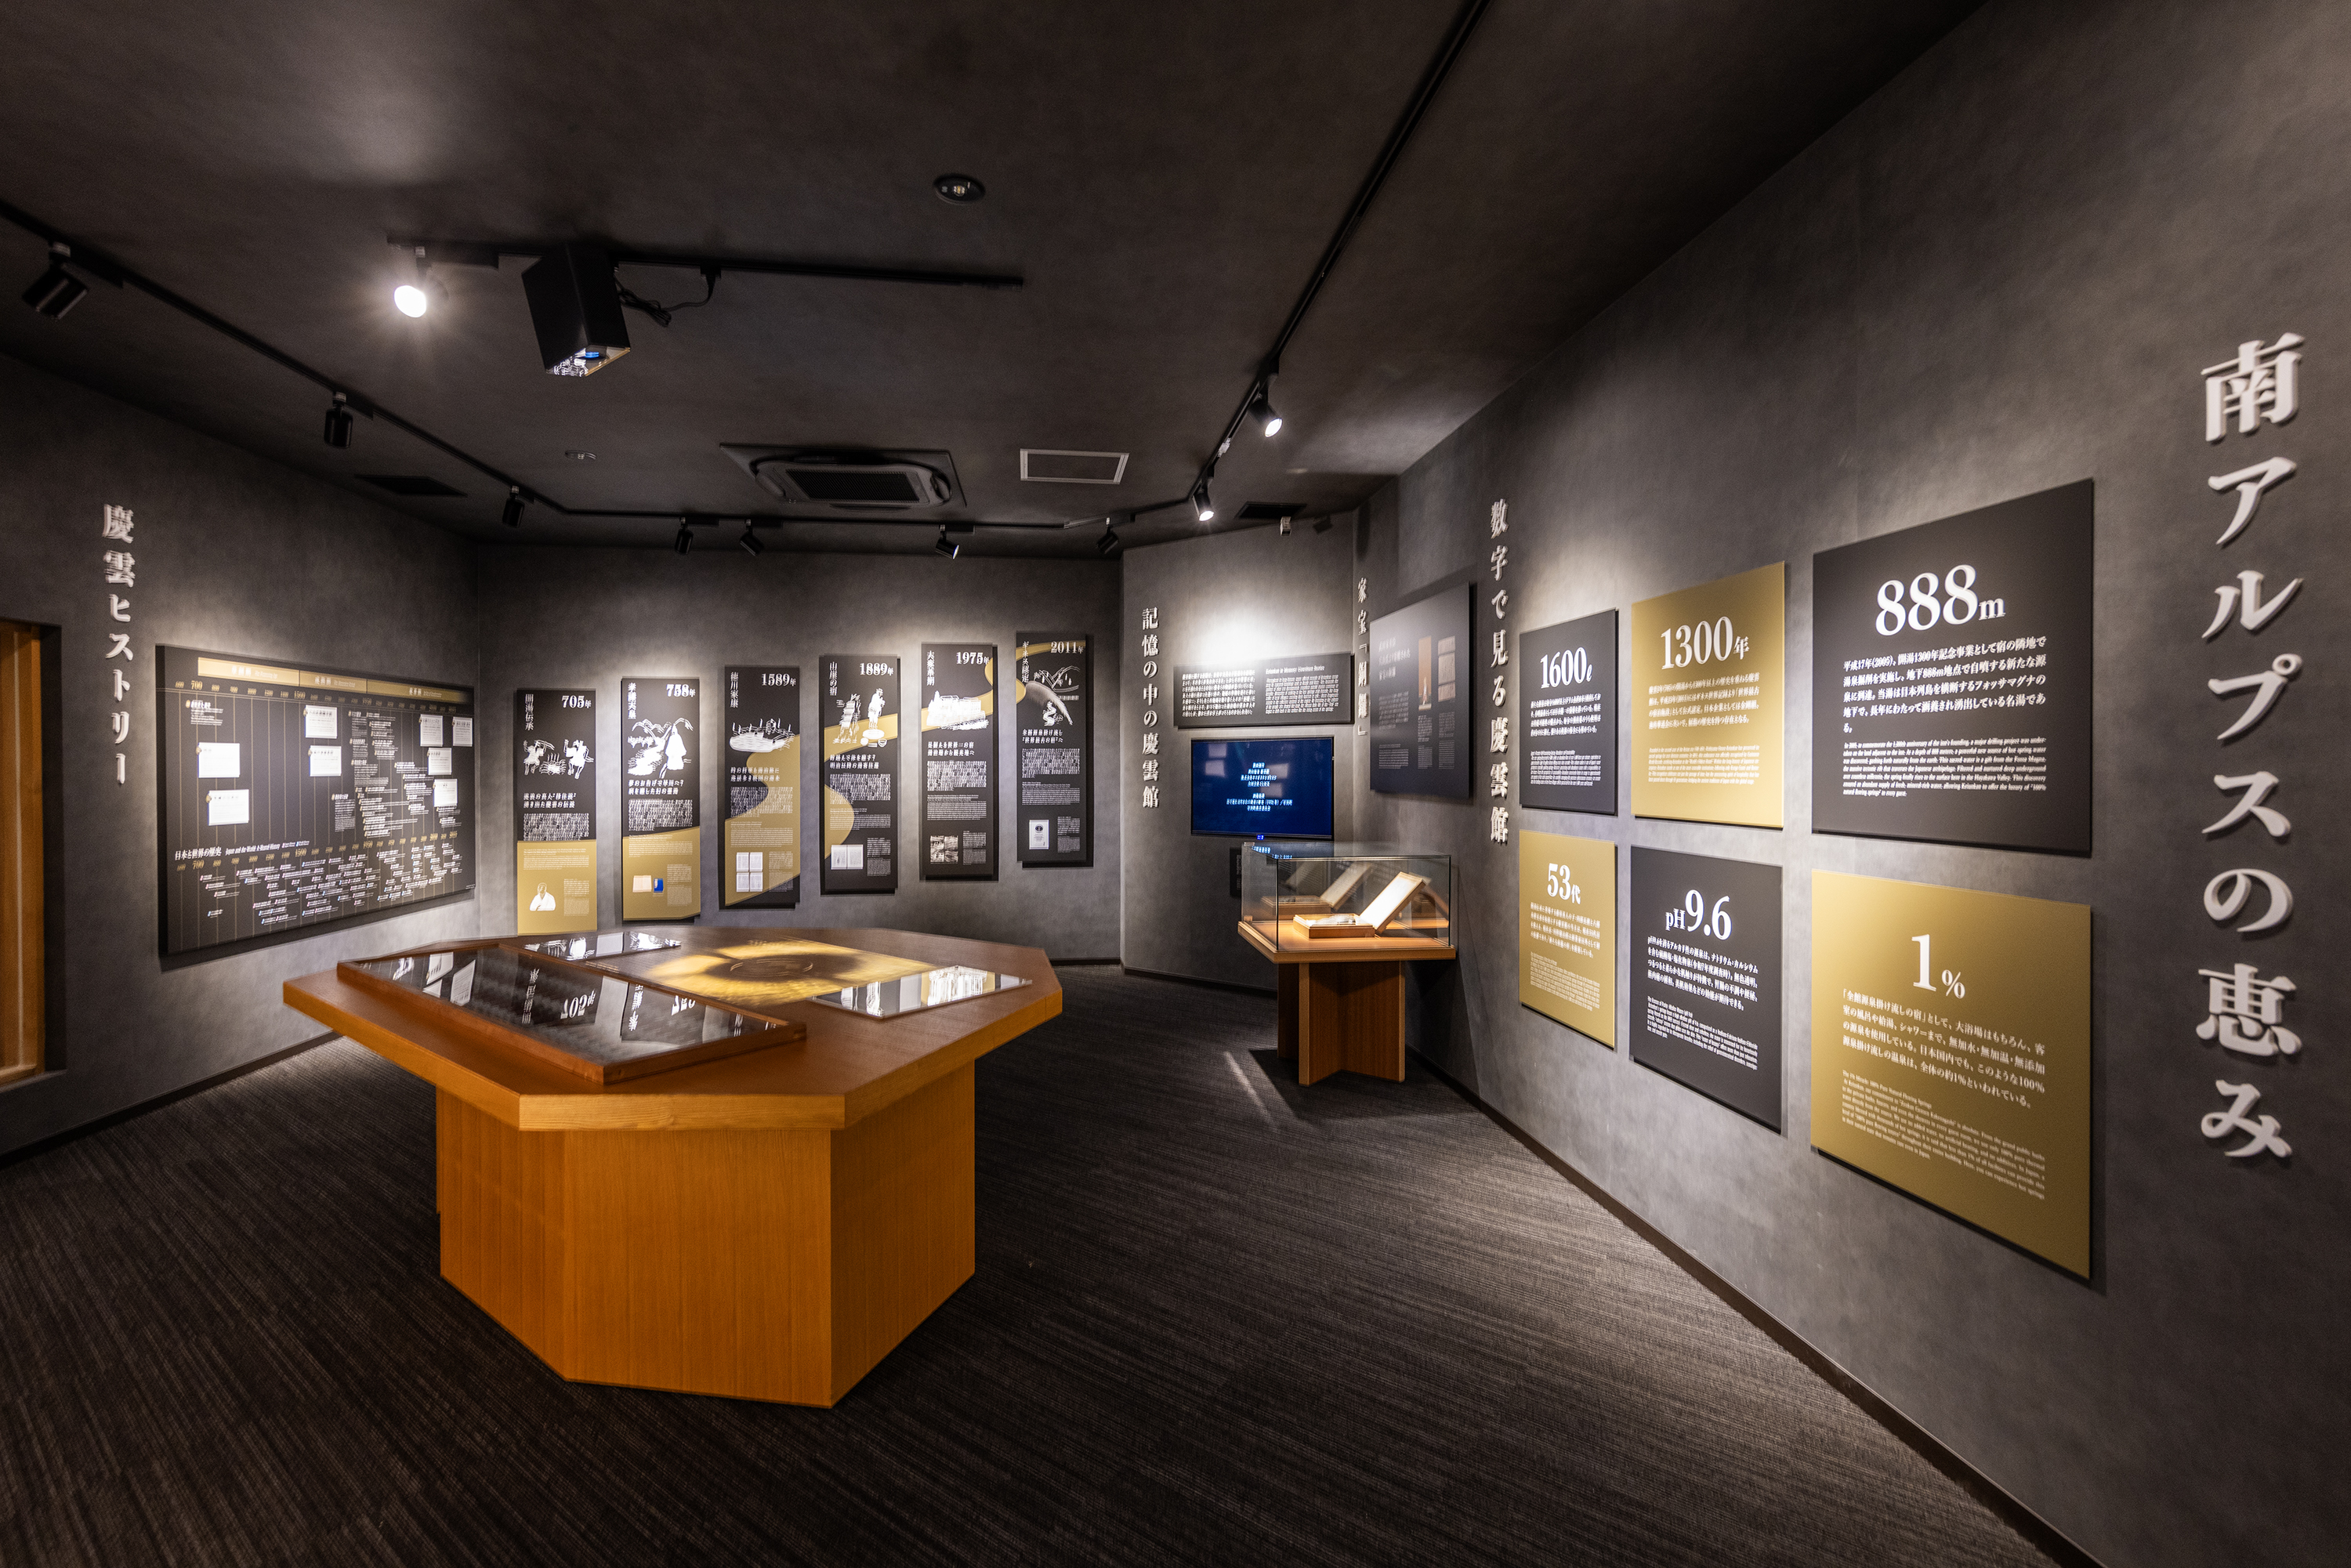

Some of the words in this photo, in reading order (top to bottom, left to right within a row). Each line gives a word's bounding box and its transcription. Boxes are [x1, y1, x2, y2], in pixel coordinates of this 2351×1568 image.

[1875, 564, 2005, 636] 888m
[103, 503, 135, 784] 慶雲ヒストリー
[956, 651, 989, 665] 1975年
[1051, 641, 1084, 654] 2011年
[1661, 616, 1750, 670] 1300年
[190, 680, 203, 690] 700
[730, 672, 738, 708] 徳川家康
[1490, 498, 1509, 844] 数字で見る慶雲館
[524, 693, 534, 730] 開湯伝承
[561, 694, 592, 709] 705年
[1142, 607, 1159, 809] 記憶の中の慶雲館
[2197, 331, 2306, 1158] 南アルプスの恵み
[175, 846, 222, 861] 日本と世界の歴史
[192, 860, 204, 870] 700
[1547, 862, 1581, 904] 53代
[1665, 889, 1732, 940] pH9.6
[1911, 933, 1965, 999] 1%
